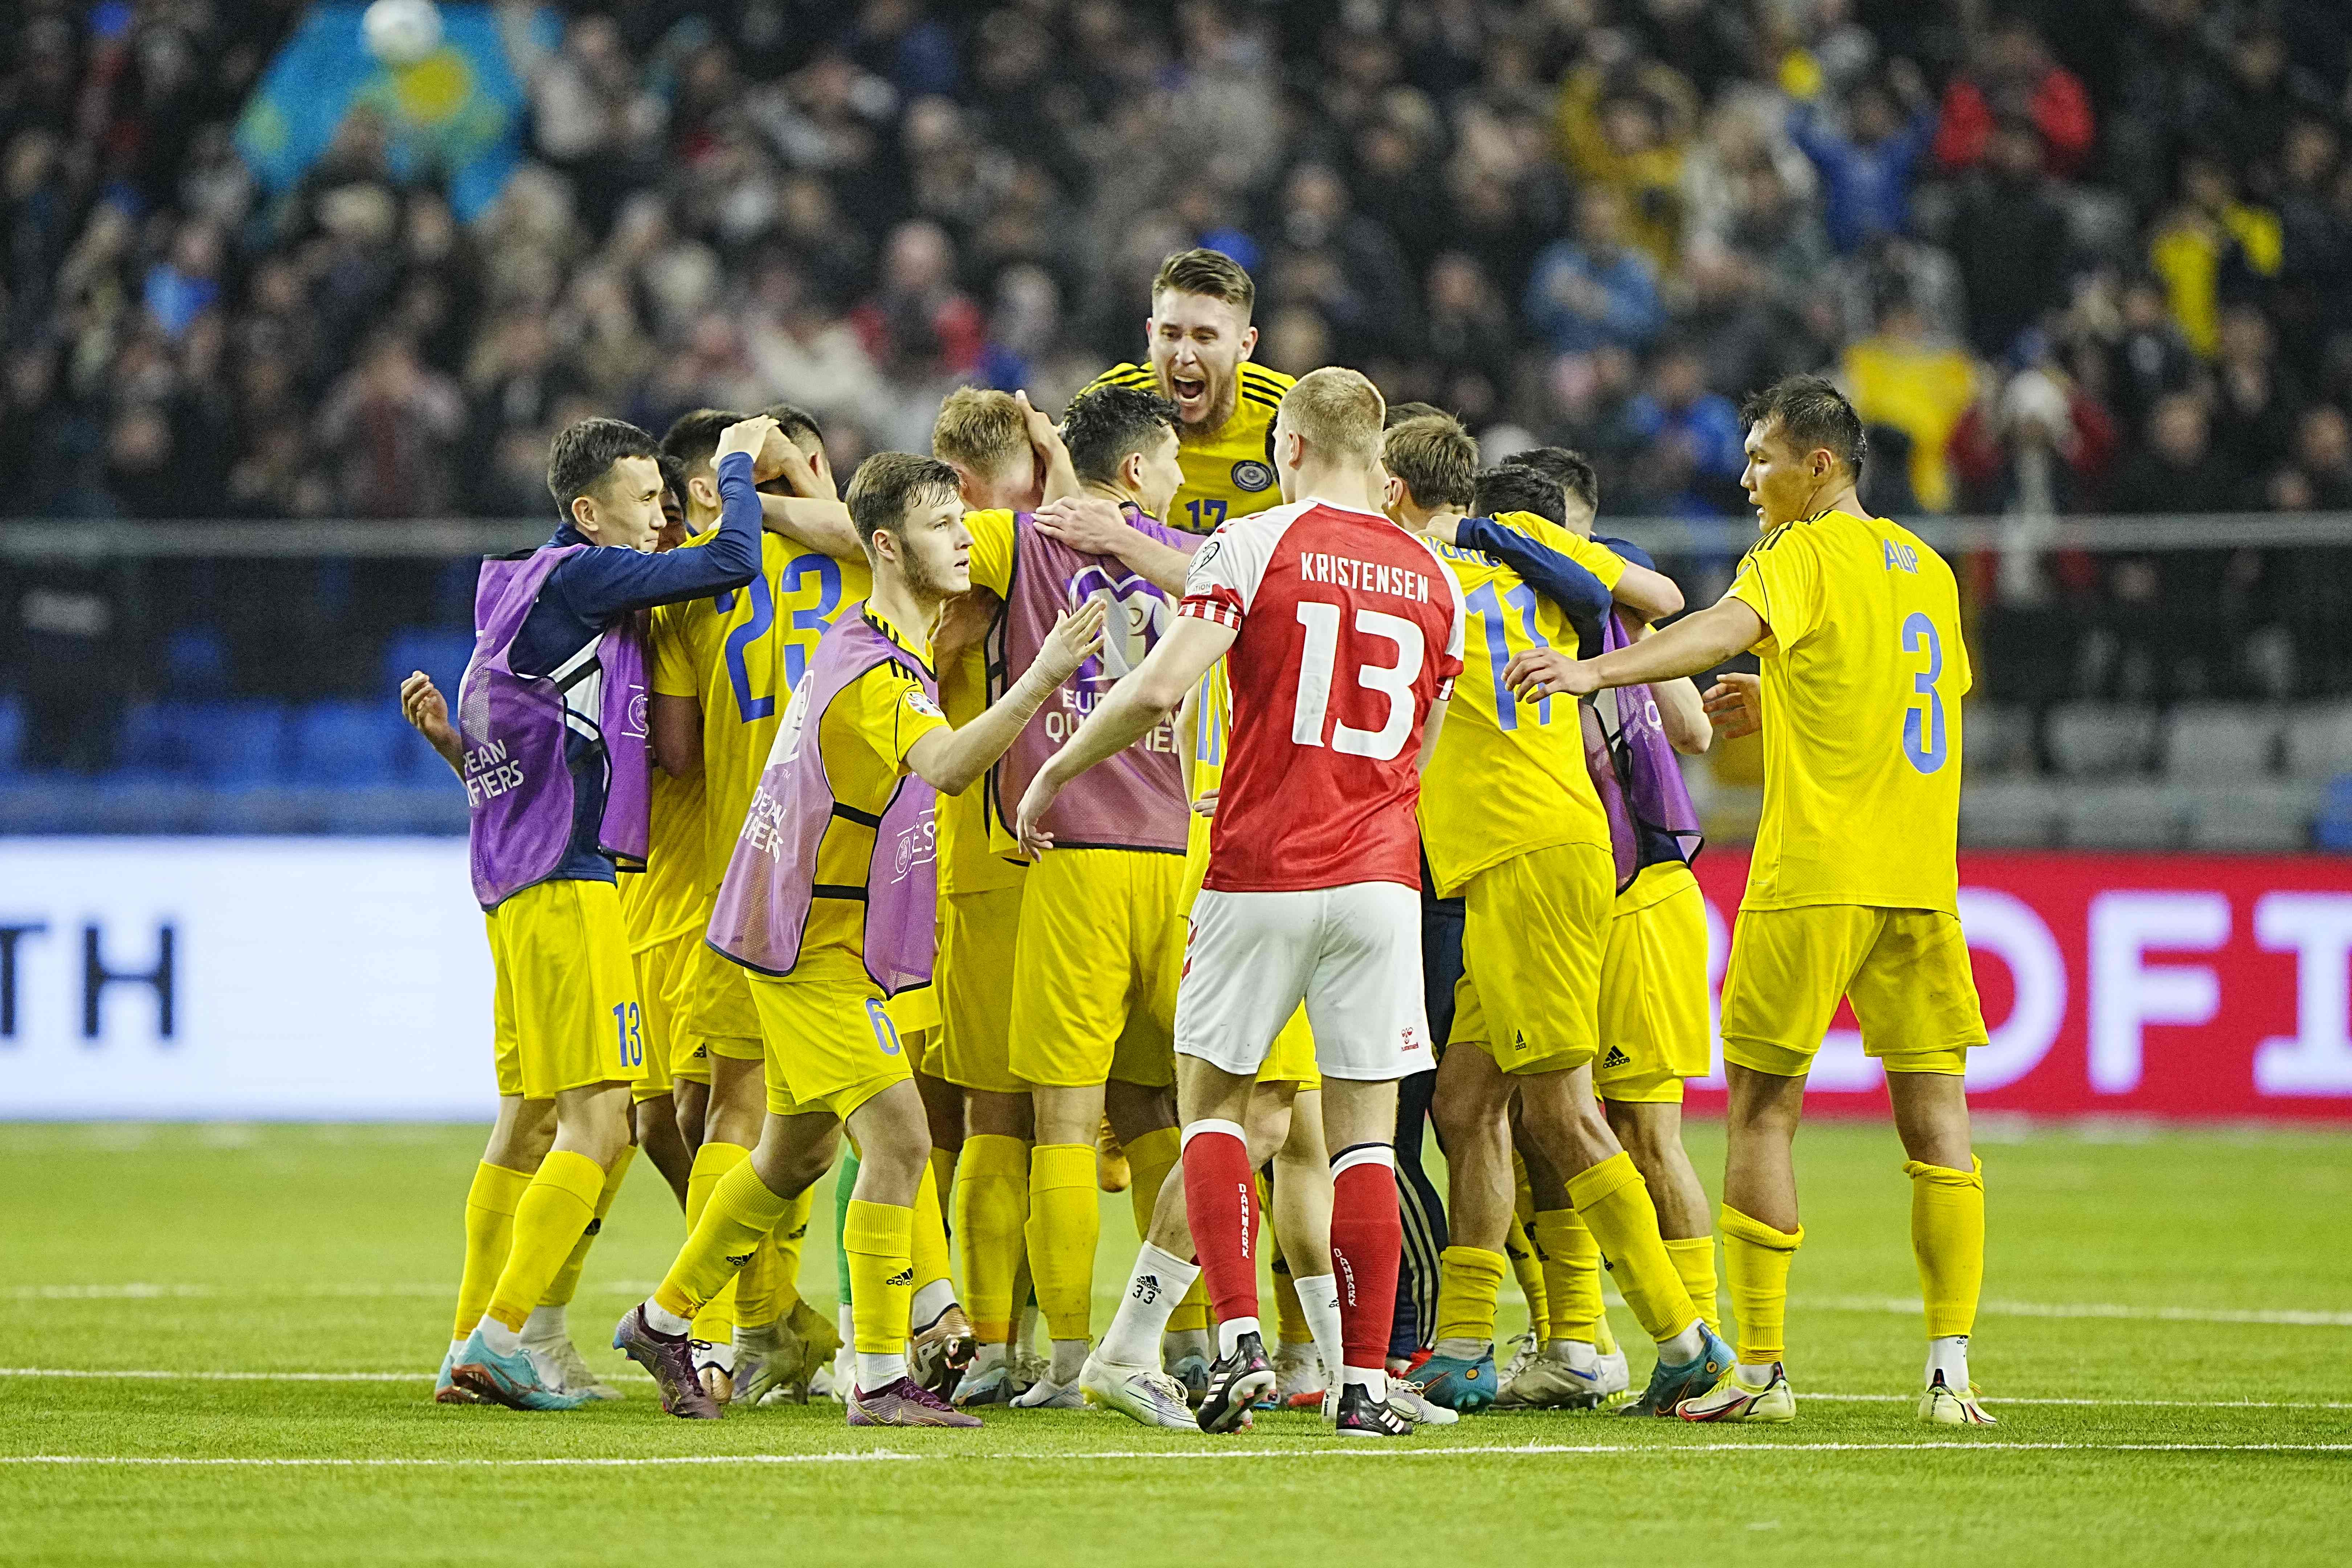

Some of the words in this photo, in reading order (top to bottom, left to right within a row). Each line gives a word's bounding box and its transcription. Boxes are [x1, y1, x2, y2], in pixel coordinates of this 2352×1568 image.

[1185, 499, 1228, 529] 17
[1301, 552, 1429, 604] KRISTENSEN
[714, 553, 841, 724] 23
[1465, 580, 1550, 730] 11
[1292, 601, 1425, 761] 13
[1902, 612, 1947, 773] 3
[0, 924, 173, 1037] TH
[612, 1001, 642, 1067] 13
[865, 997, 901, 1056] 6
[1603, 1057, 1630, 1069] adidas
[1238, 1183, 1249, 1259] DANMARK
[1136, 1278, 1162, 1294] adidas
[1334, 1248, 1357, 1307] DANMARK
